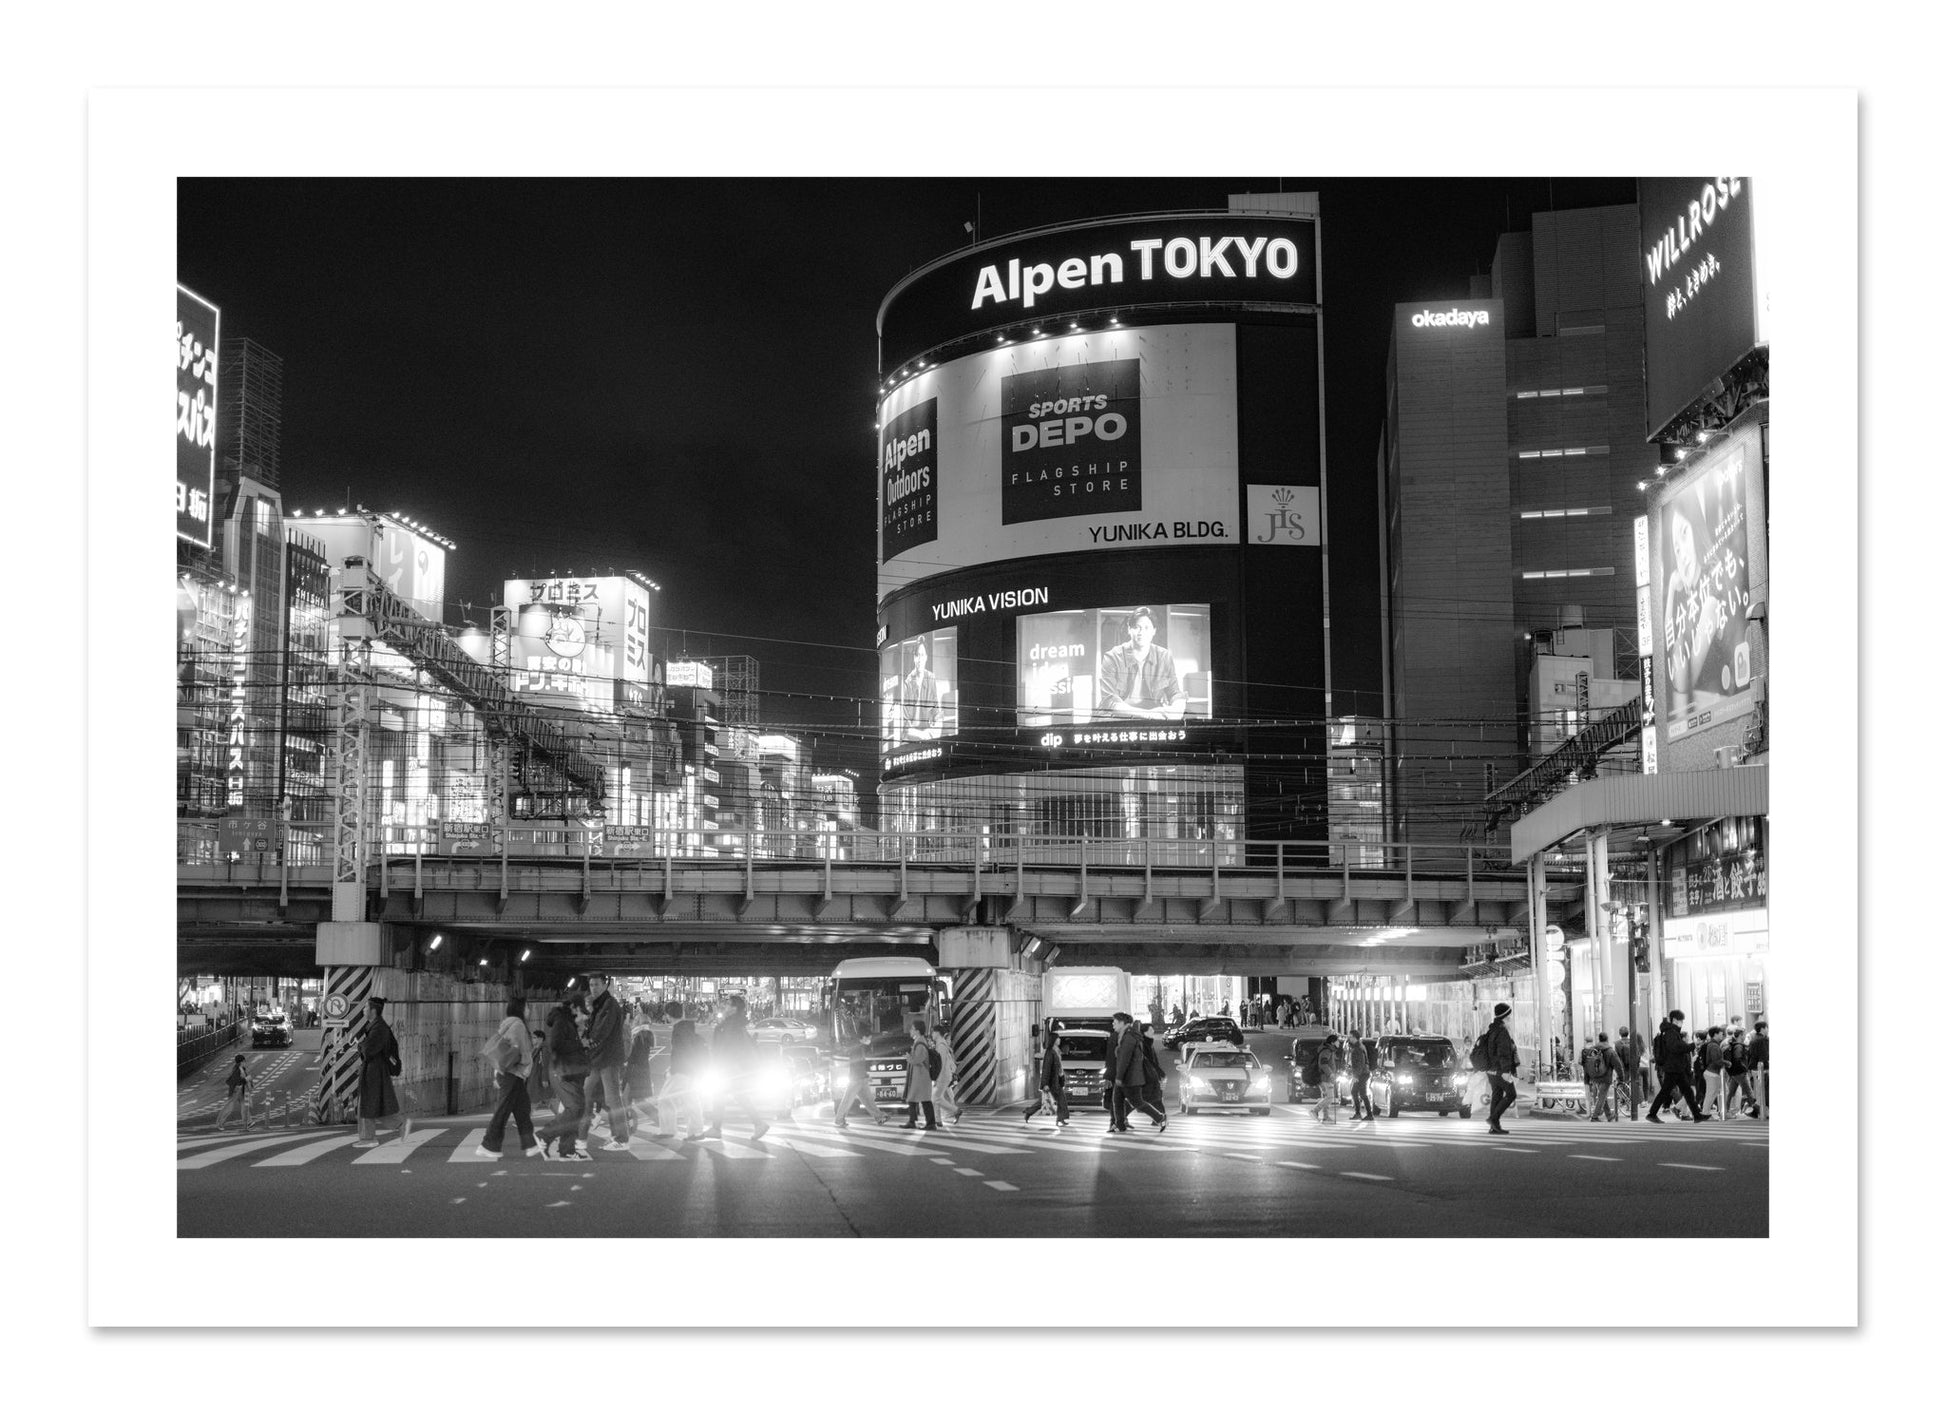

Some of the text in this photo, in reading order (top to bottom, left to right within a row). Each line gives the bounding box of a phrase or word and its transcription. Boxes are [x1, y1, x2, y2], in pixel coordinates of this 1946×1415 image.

[1646, 177, 1741, 287] WILLROSE
[971, 236, 1299, 310] Alpen TOKYO
[1411, 308, 1489, 329] okadaya
[1028, 394, 1108, 420] SPORTS
[1012, 412, 1128, 453] DEPO
[884, 428, 931, 474] Alpen
[887, 466, 930, 506] Outdoors
[1012, 461, 1129, 485] FLAGSHIP
[1053, 478, 1129, 496] STORE
[884, 494, 931, 527] FLAGSHIP
[897, 510, 931, 534] STORE
[1089, 521, 1229, 543] YUNIKA BLDG.
[932, 586, 1049, 621] YUNIKA VISION
[1030, 643, 1085, 660] dream
[1041, 732, 1063, 749] dip
